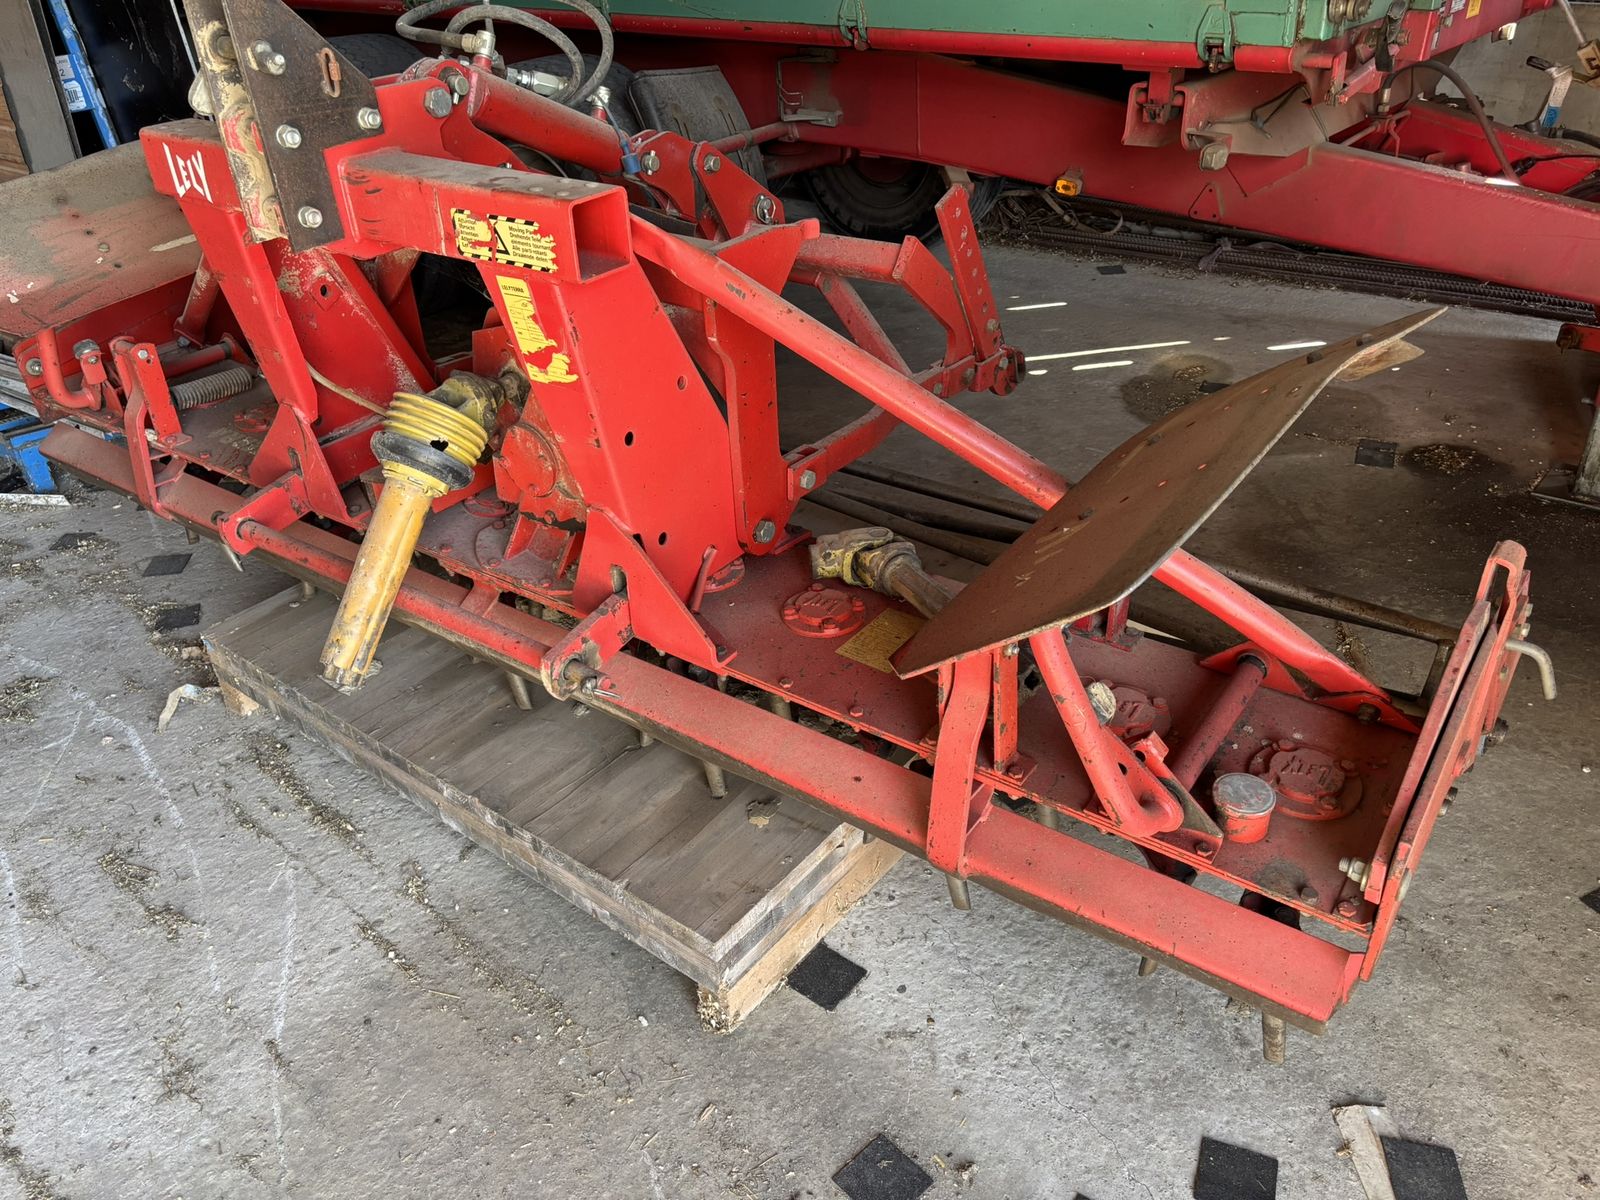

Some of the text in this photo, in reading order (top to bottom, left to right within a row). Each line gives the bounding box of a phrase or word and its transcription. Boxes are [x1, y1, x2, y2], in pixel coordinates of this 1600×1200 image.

[162, 141, 214, 204] LELY
[508, 226, 525, 235] Moving
[510, 232, 531, 241] Drehende
